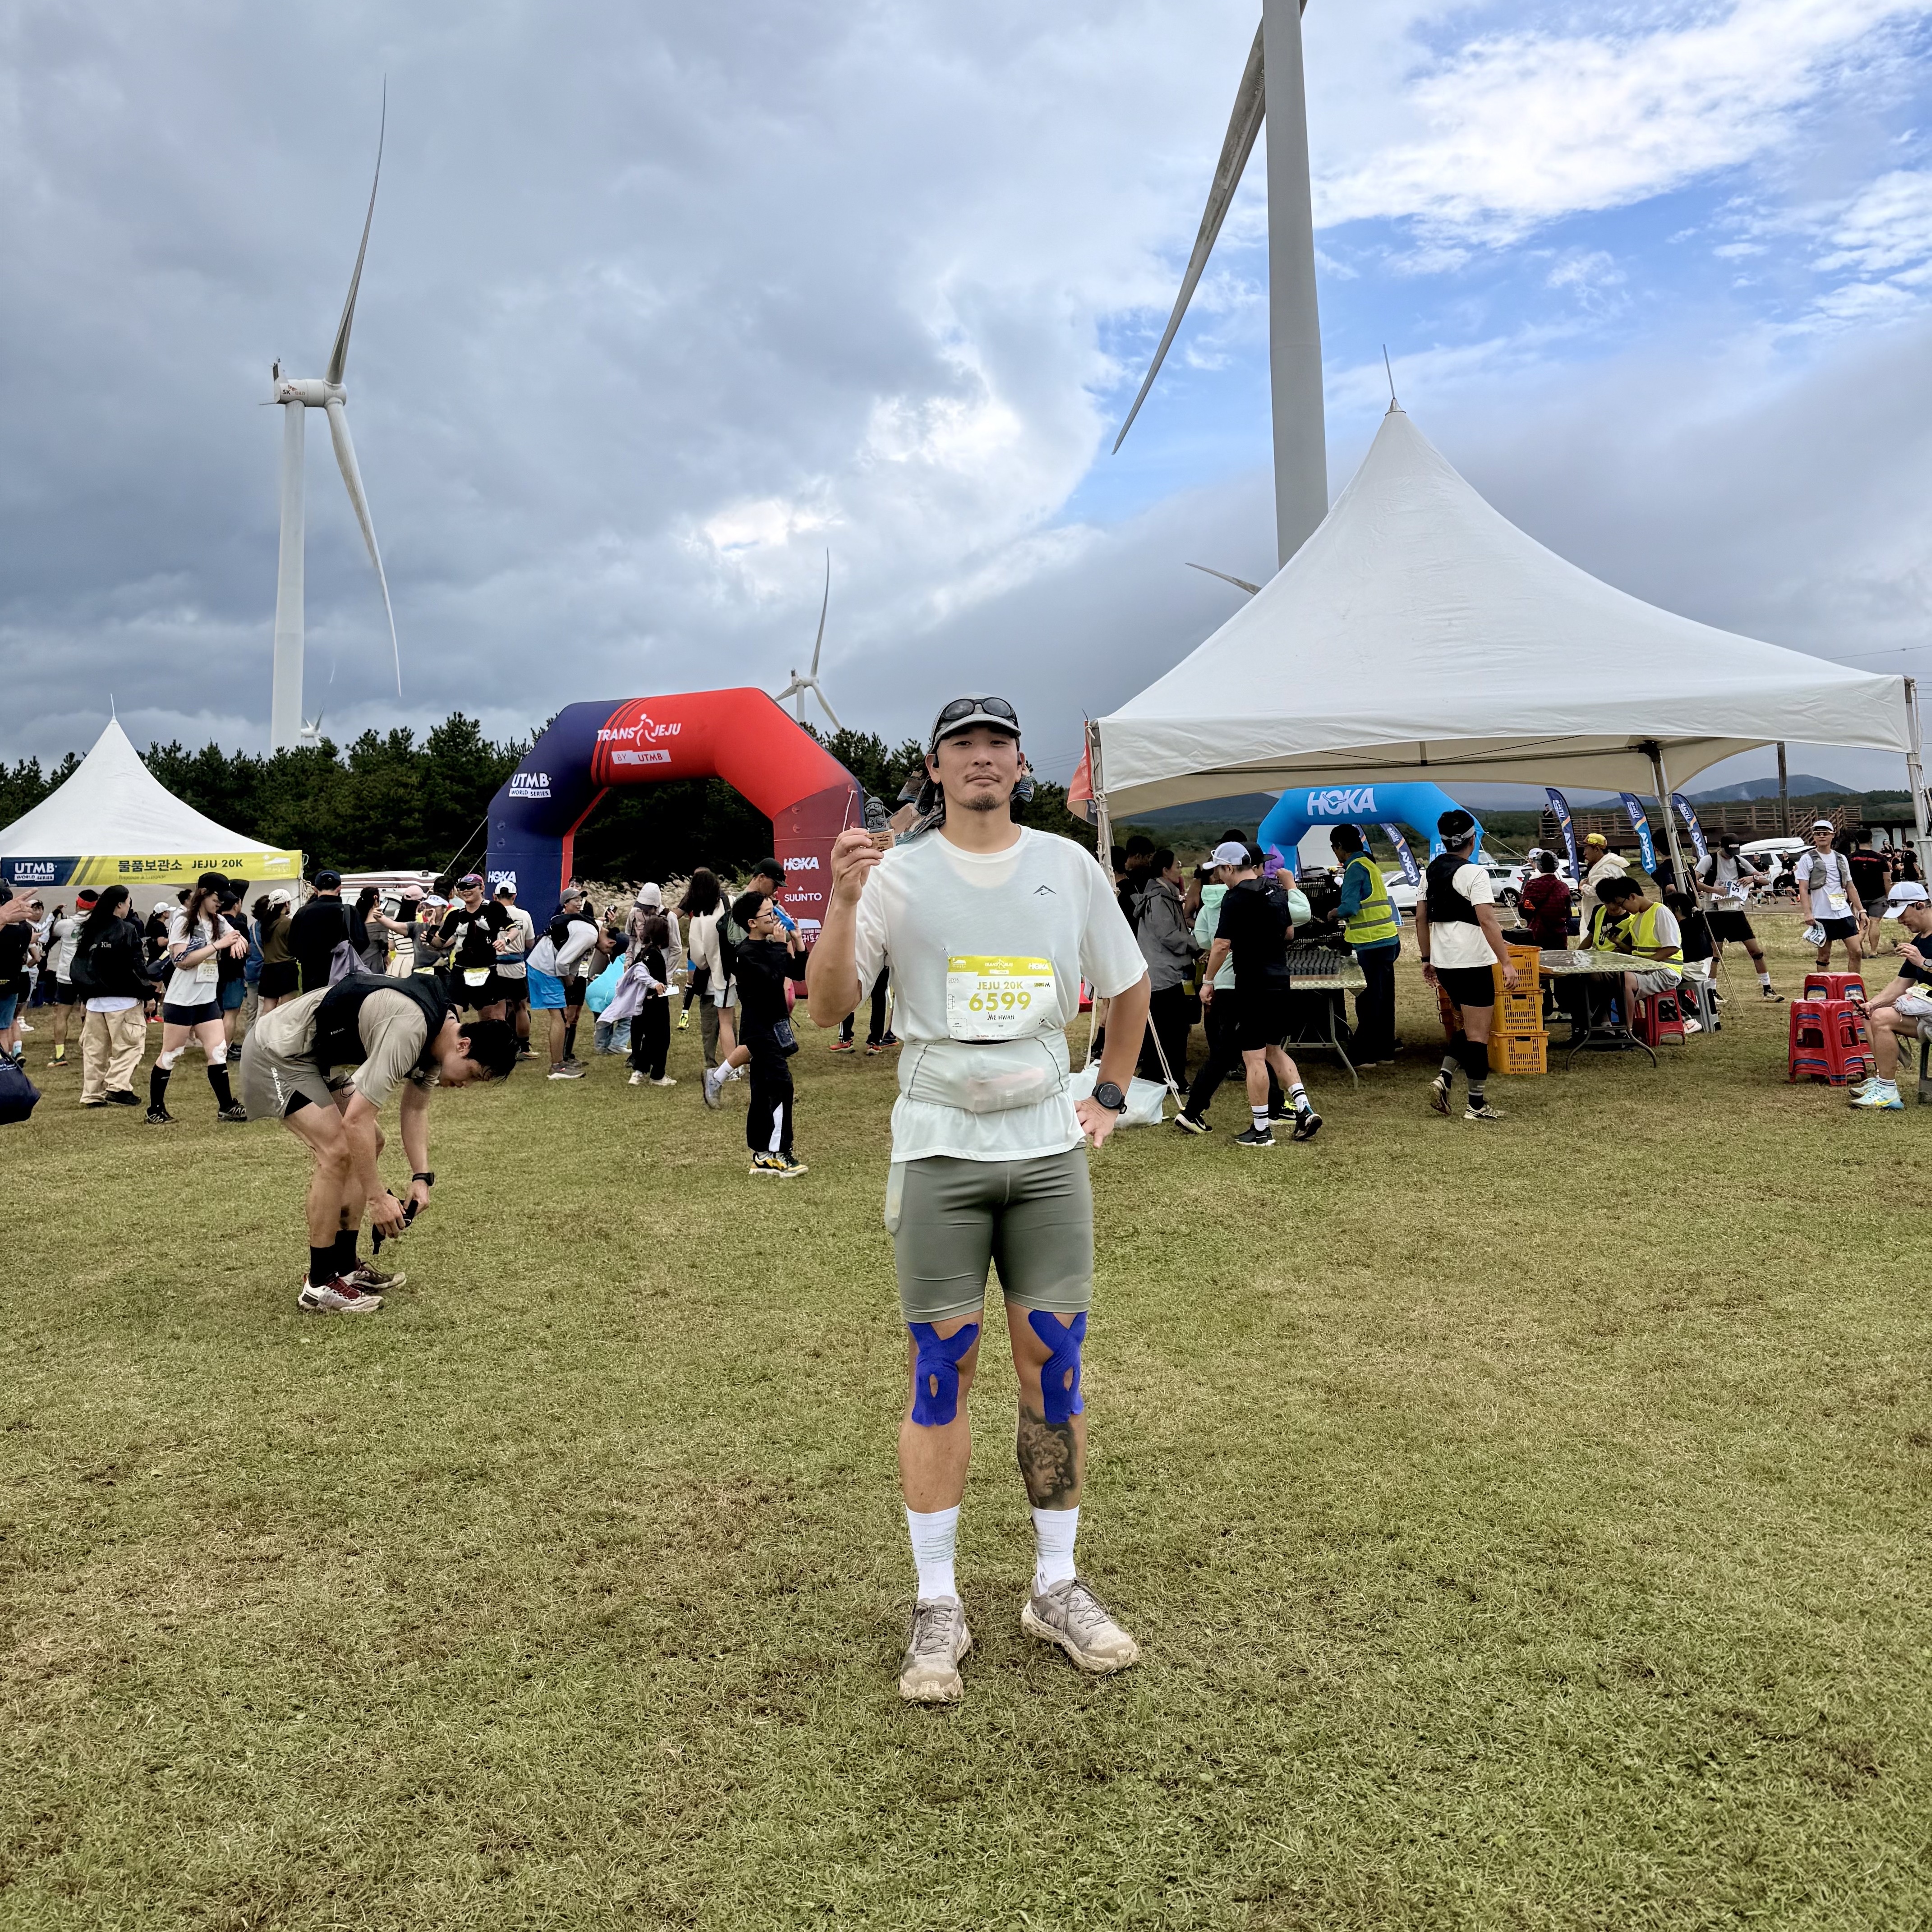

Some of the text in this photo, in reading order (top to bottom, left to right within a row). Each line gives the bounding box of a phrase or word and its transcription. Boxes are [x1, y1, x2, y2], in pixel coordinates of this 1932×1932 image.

[597, 723, 682, 741] TRANS JEJU
[617, 753, 663, 762] BY UTMB
[512, 773, 549, 787] UTMB
[1307, 787, 1378, 815] HOKA
[1436, 842, 1447, 852] FL
[15, 862, 55, 874] UTMB
[118, 859, 183, 872] 물품보관소
[192, 859, 243, 869] JEJU 20K
[783, 857, 820, 871] HOKA
[488, 871, 516, 883] HOKA
[784, 892, 822, 902] SUUNTO
[977, 981, 1024, 990] JEJU 20K
[968, 991, 1032, 1012] 6599
[271, 1067, 285, 1106] SALOMON
